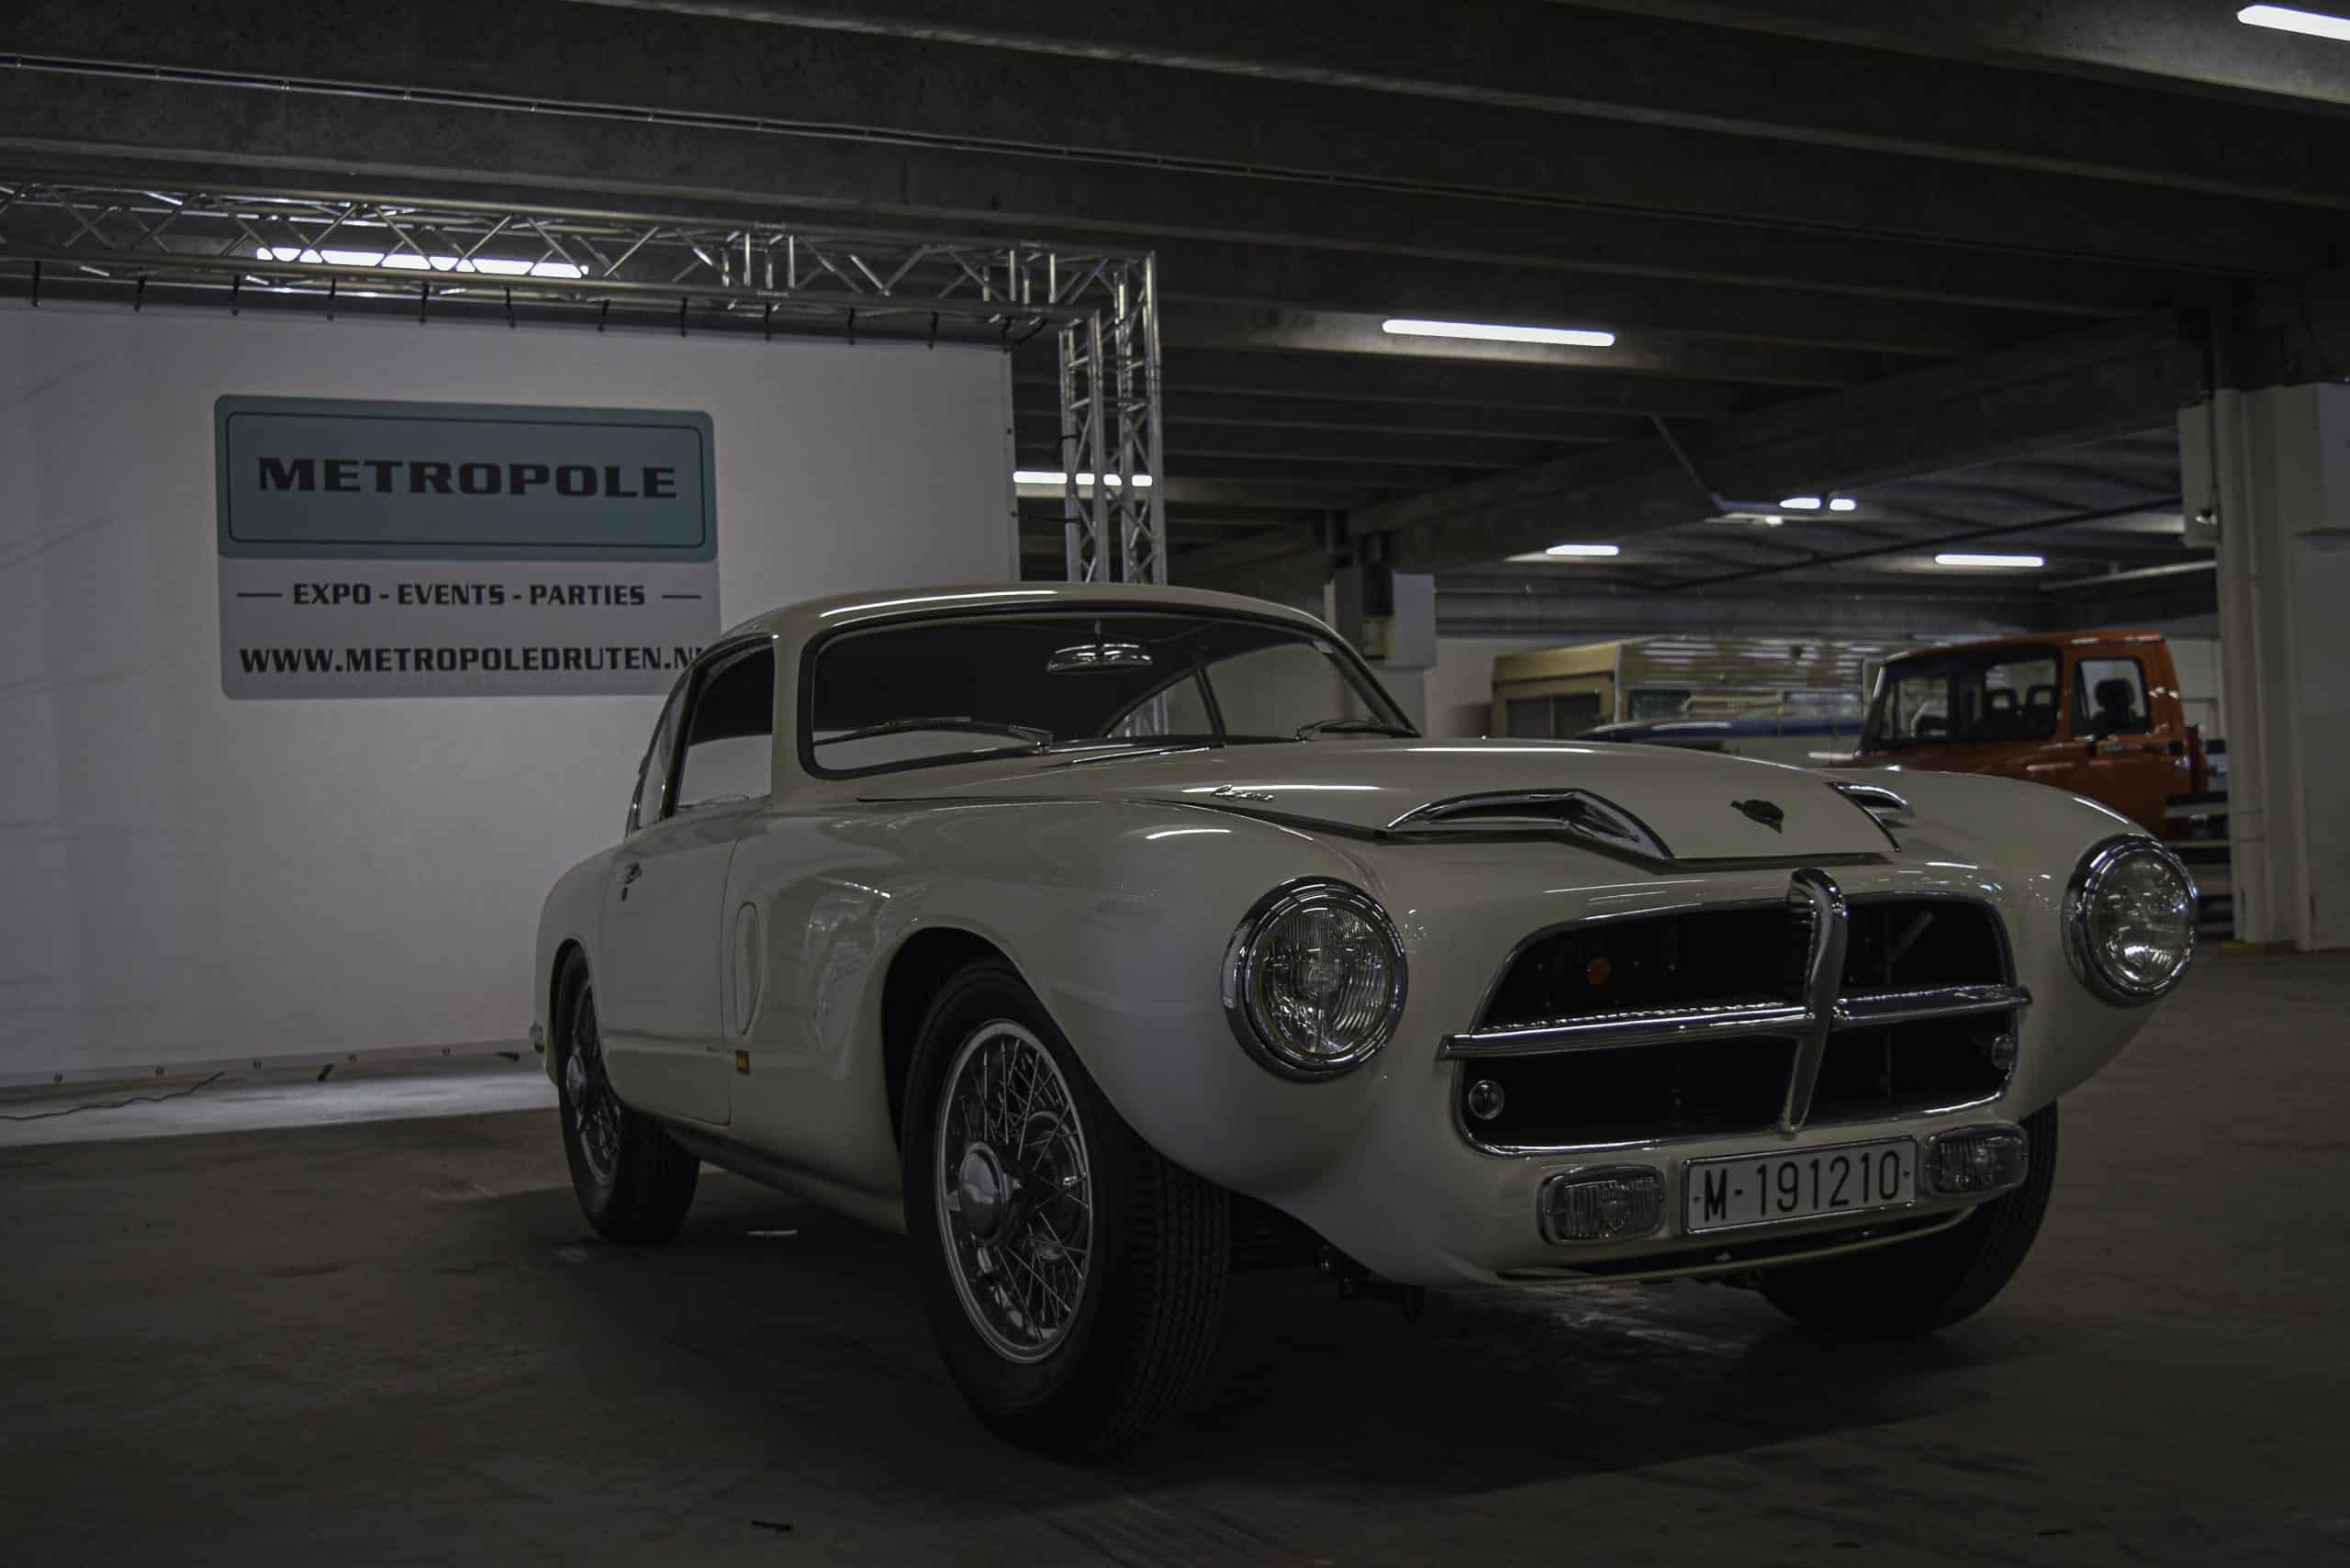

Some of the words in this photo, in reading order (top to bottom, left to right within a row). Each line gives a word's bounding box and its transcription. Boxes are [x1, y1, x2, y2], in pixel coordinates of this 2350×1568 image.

[258, 456, 677, 498] METROPOLE
[293, 583, 371, 605] EXPO
[397, 583, 505, 606] EVENTS
[530, 584, 646, 606] PARTIES
[1704, 1149, 1900, 1222] M-191210
